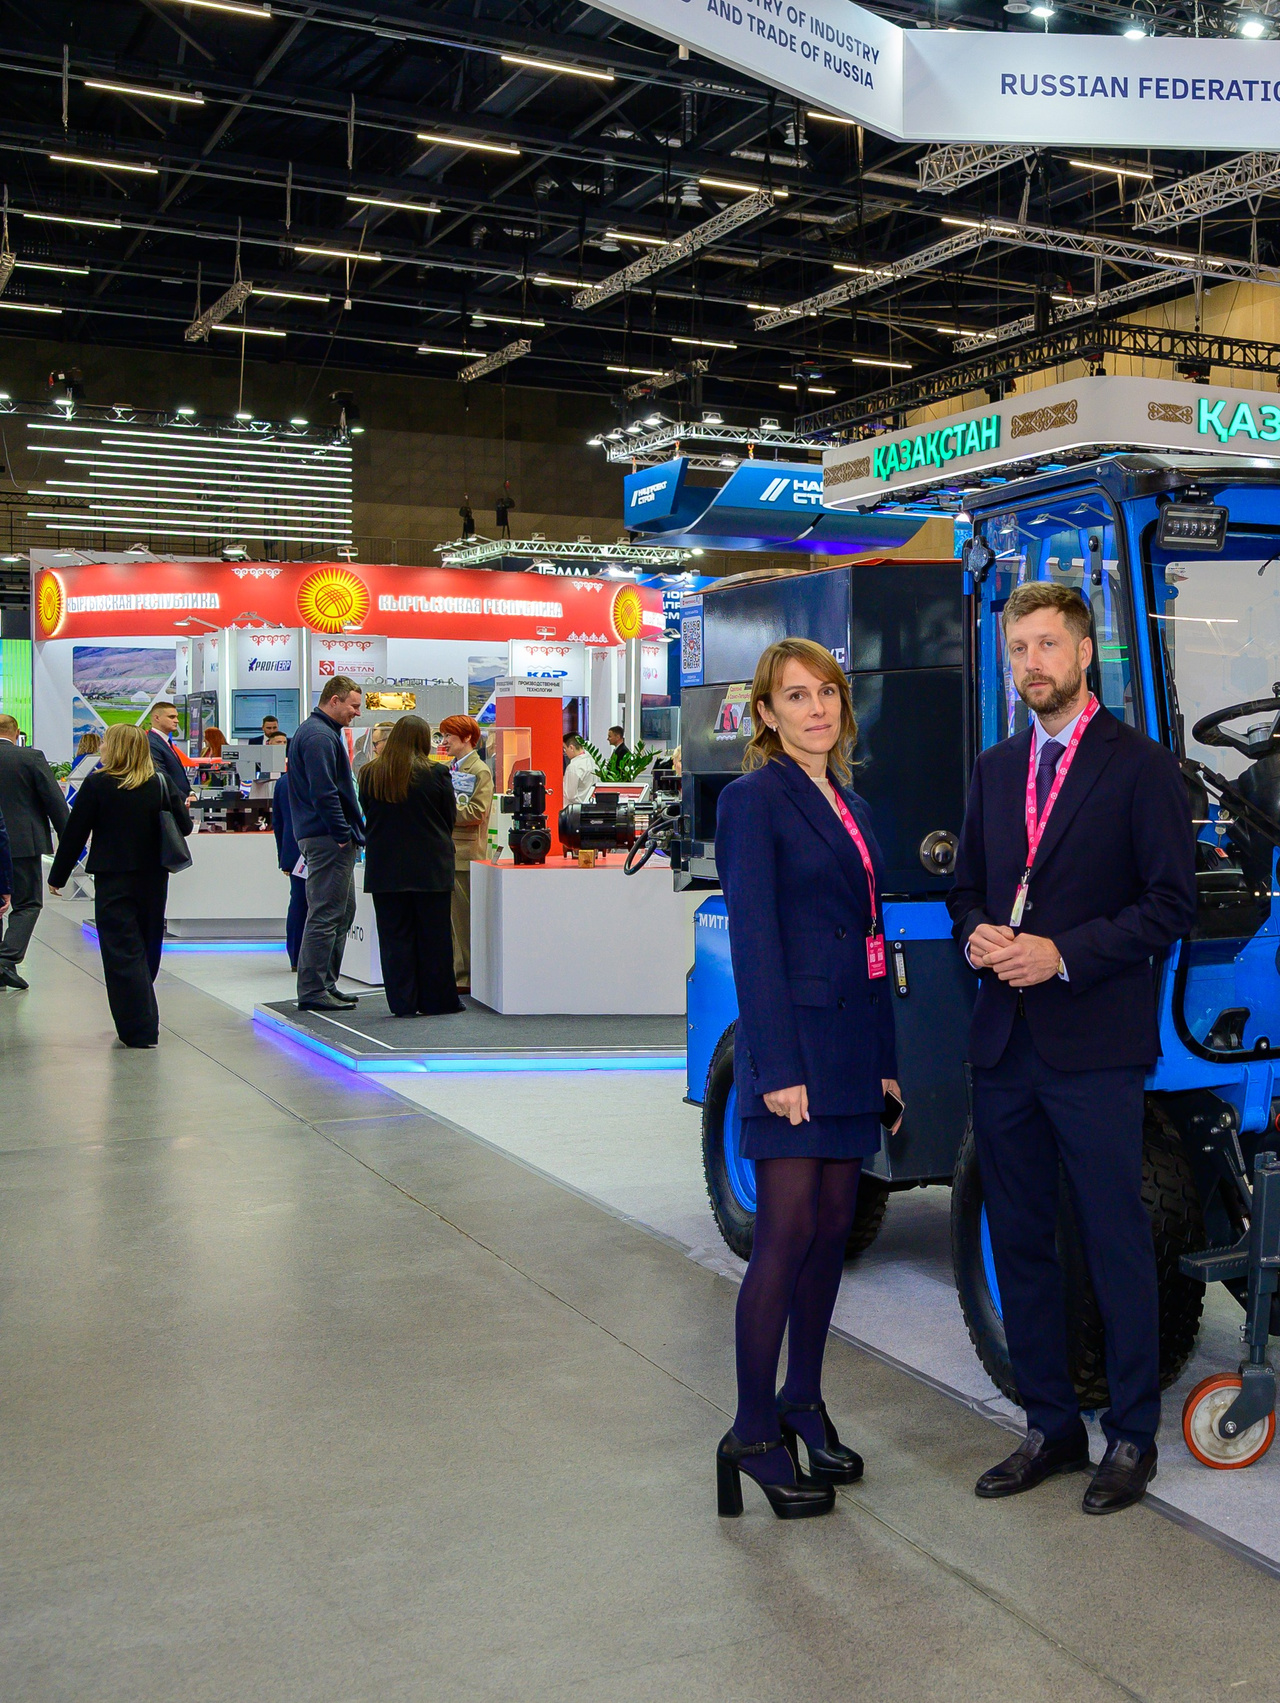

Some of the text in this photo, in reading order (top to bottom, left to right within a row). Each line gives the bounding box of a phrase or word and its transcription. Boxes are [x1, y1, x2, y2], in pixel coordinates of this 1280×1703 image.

[707, 1, 874, 91] AND TRADE OF RUSSIA
[787, 5, 806, 28] OF
[810, 16, 880, 65] INDUSTRY
[1000, 73, 1128, 98] RUSSIAN
[873, 414, 1001, 482] ҚАЗАҚСТАН
[135, 592, 220, 610] РЕСПУБЛИКА
